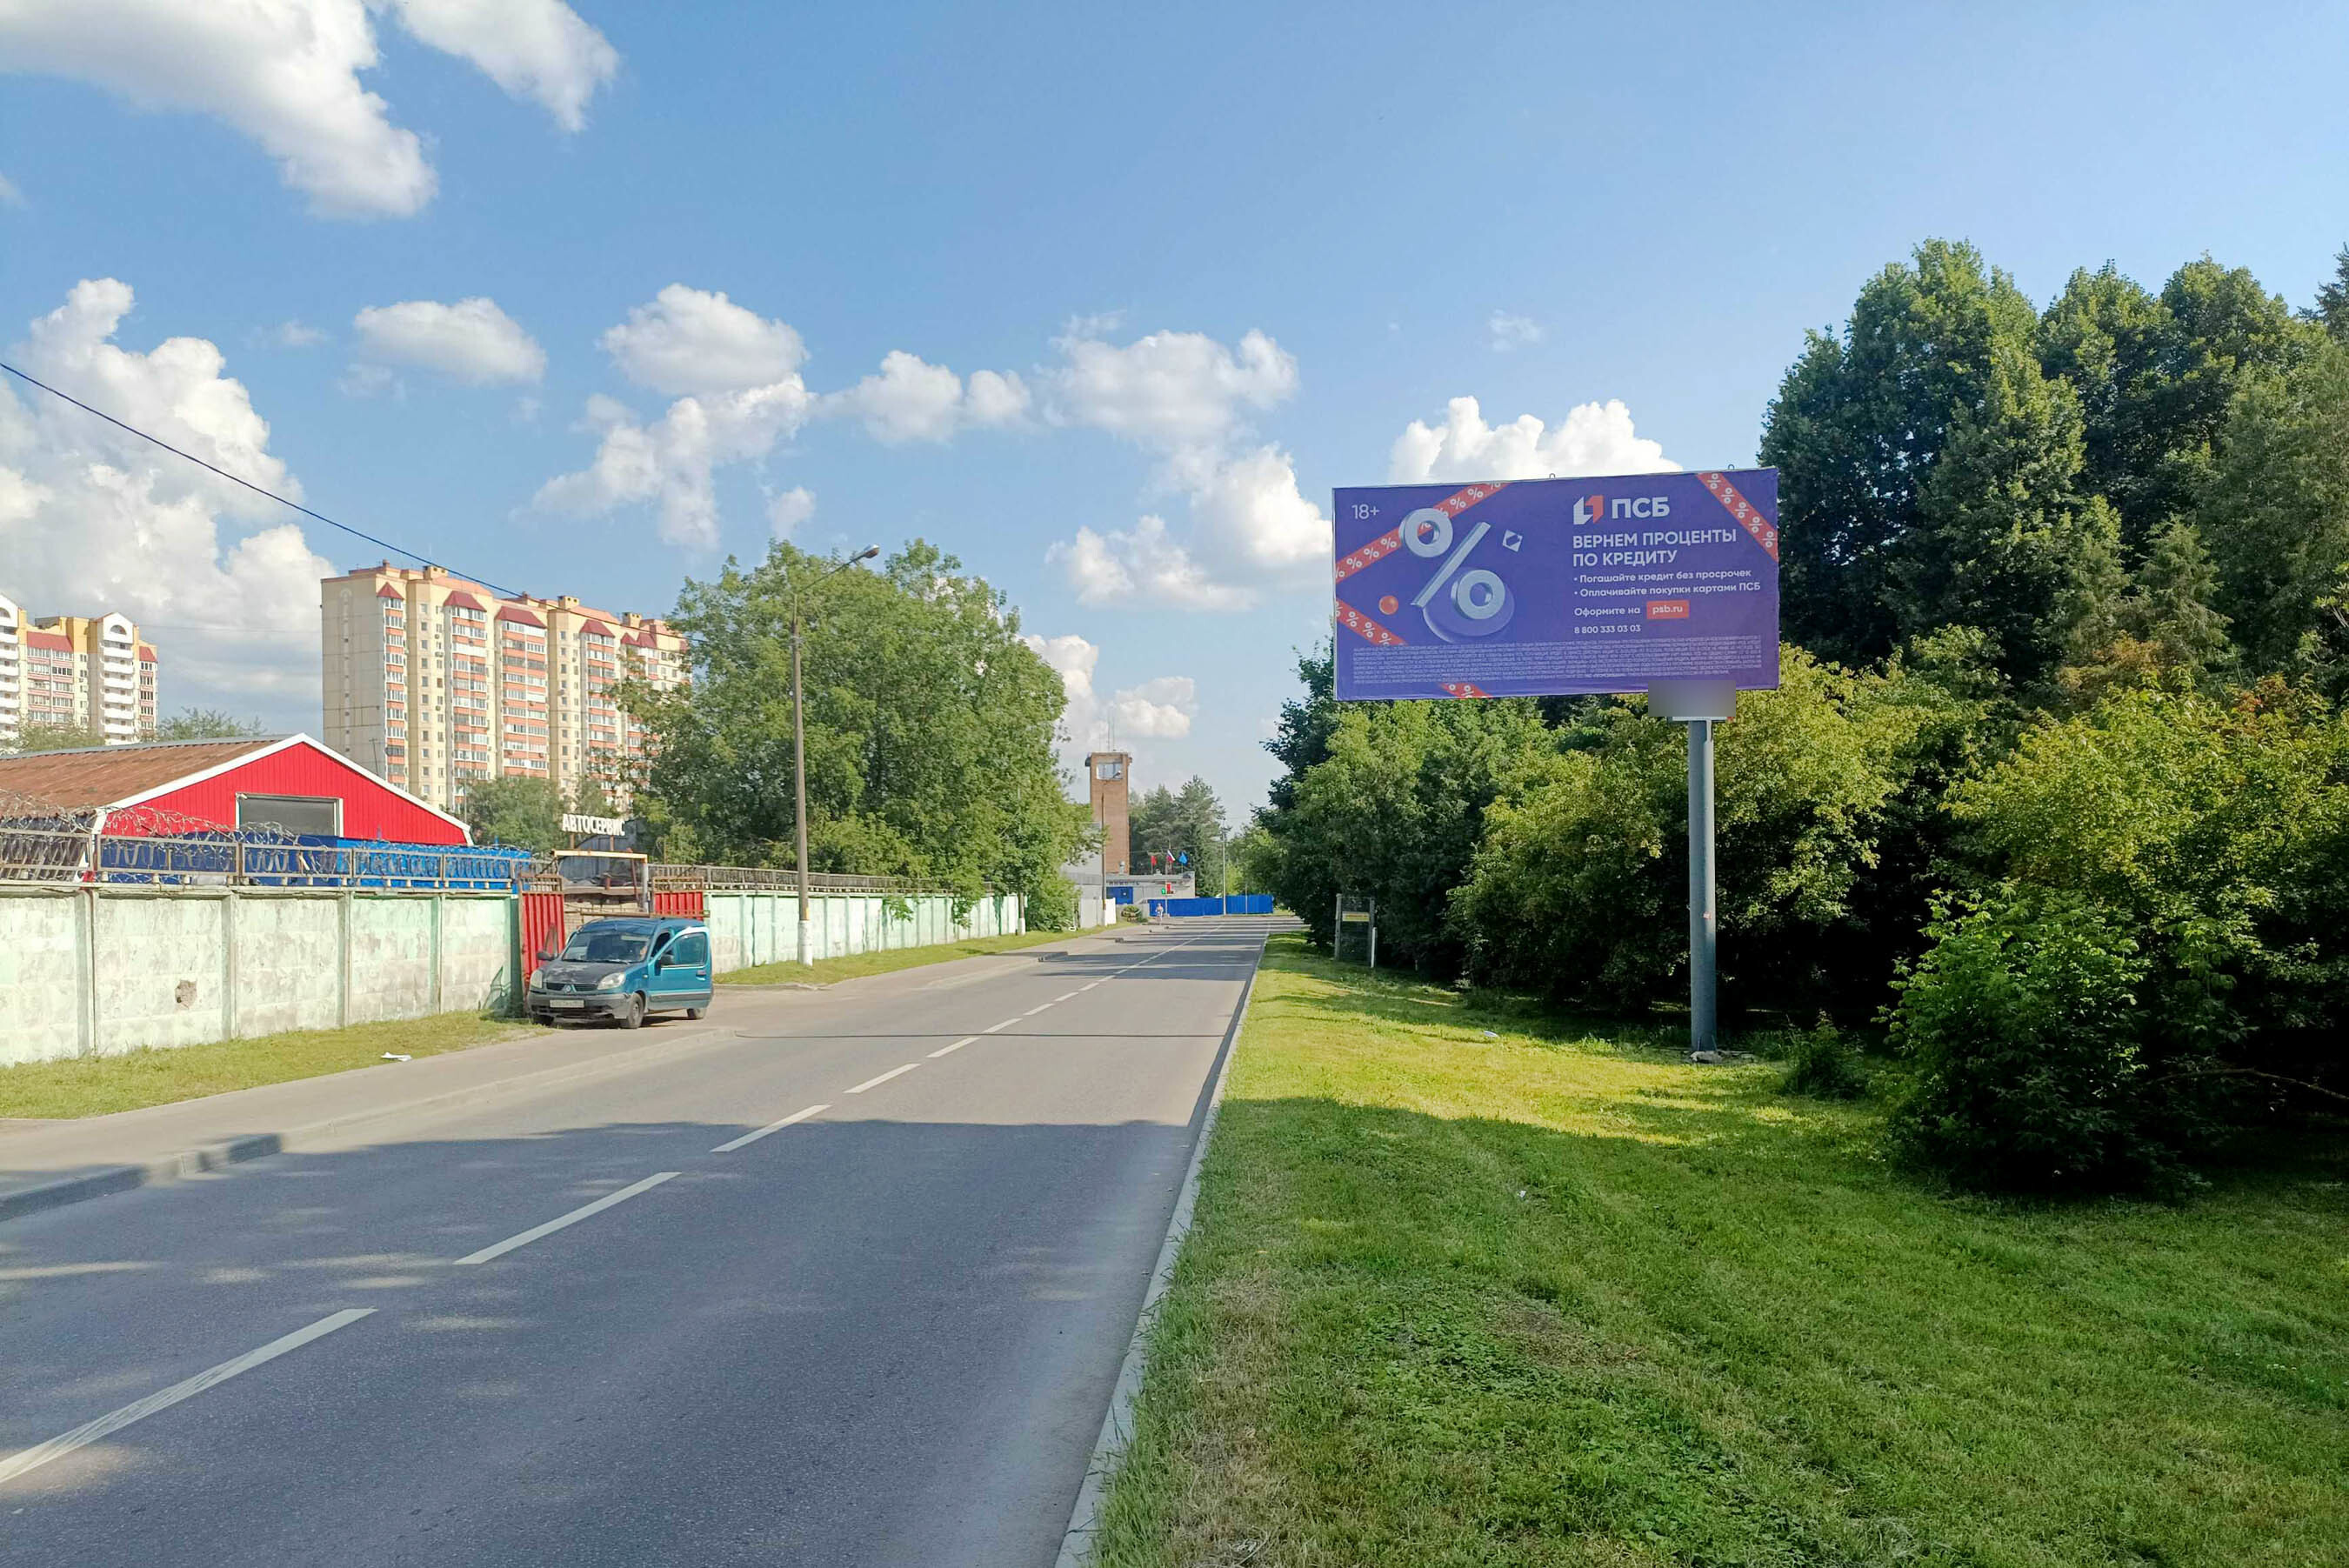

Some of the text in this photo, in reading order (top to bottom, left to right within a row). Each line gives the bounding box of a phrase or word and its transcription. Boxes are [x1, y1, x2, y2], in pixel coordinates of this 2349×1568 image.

[1351, 504, 1380, 520] 18+
[1612, 497, 1670, 519] ПСБ
[1572, 529, 1737, 549] ВЕРНЕМ ПРОЦЕНТЫ
[1572, 550, 1678, 567] ПО КРЕДИТУ
[1579, 574, 1636, 584] Погашайте
[1638, 572, 1674, 583] кредит
[1696, 570, 1752, 581] просрочек
[1579, 582, 1761, 597] Оплачивайте покупки картами ПСБ
[1574, 607, 1625, 617] Оформите
[1652, 604, 1684, 615] psb.ru
[562, 813, 625, 836] АВТОСЕРВИС
